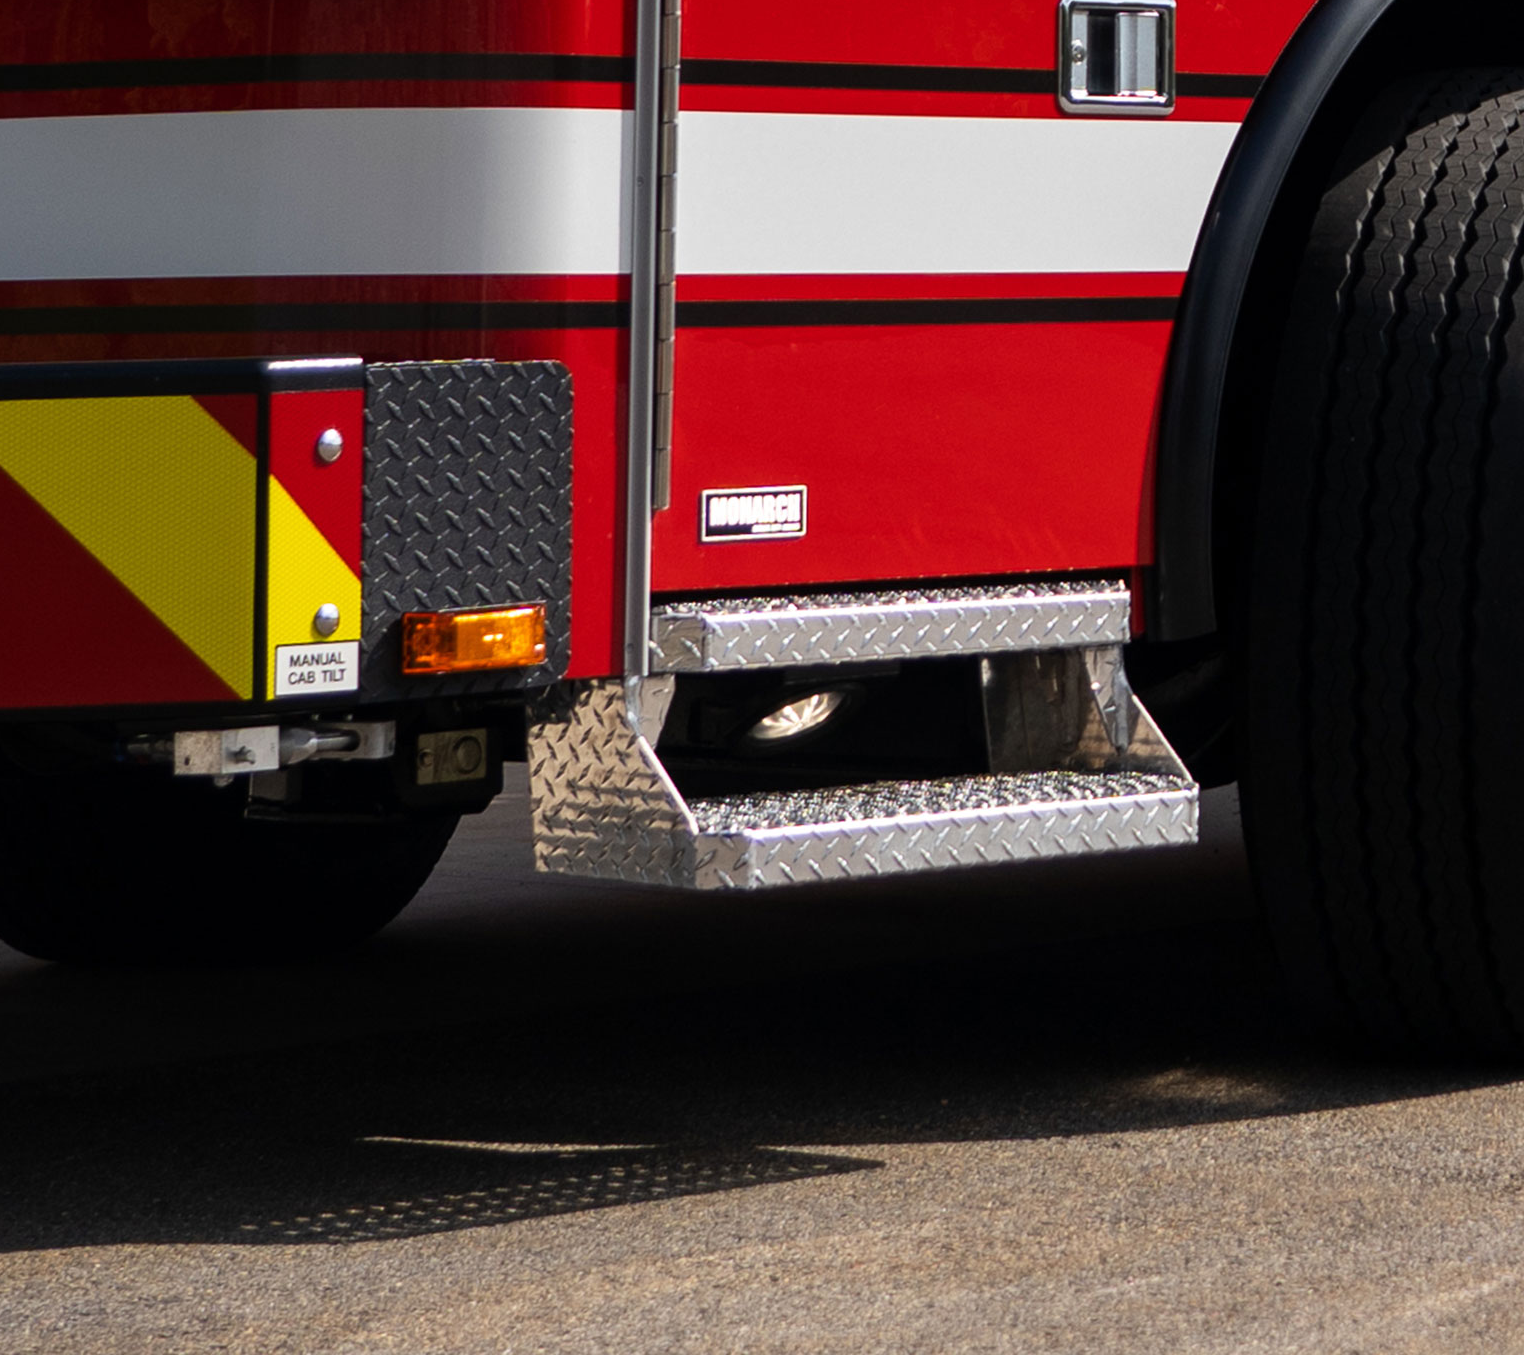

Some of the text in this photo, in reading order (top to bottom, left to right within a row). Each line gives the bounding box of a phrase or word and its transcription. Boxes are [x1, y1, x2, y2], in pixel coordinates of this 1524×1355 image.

[709, 493, 801, 526] MONARCH
[288, 652, 345, 667] MANUAL
[288, 668, 346, 685] CAB TILT
